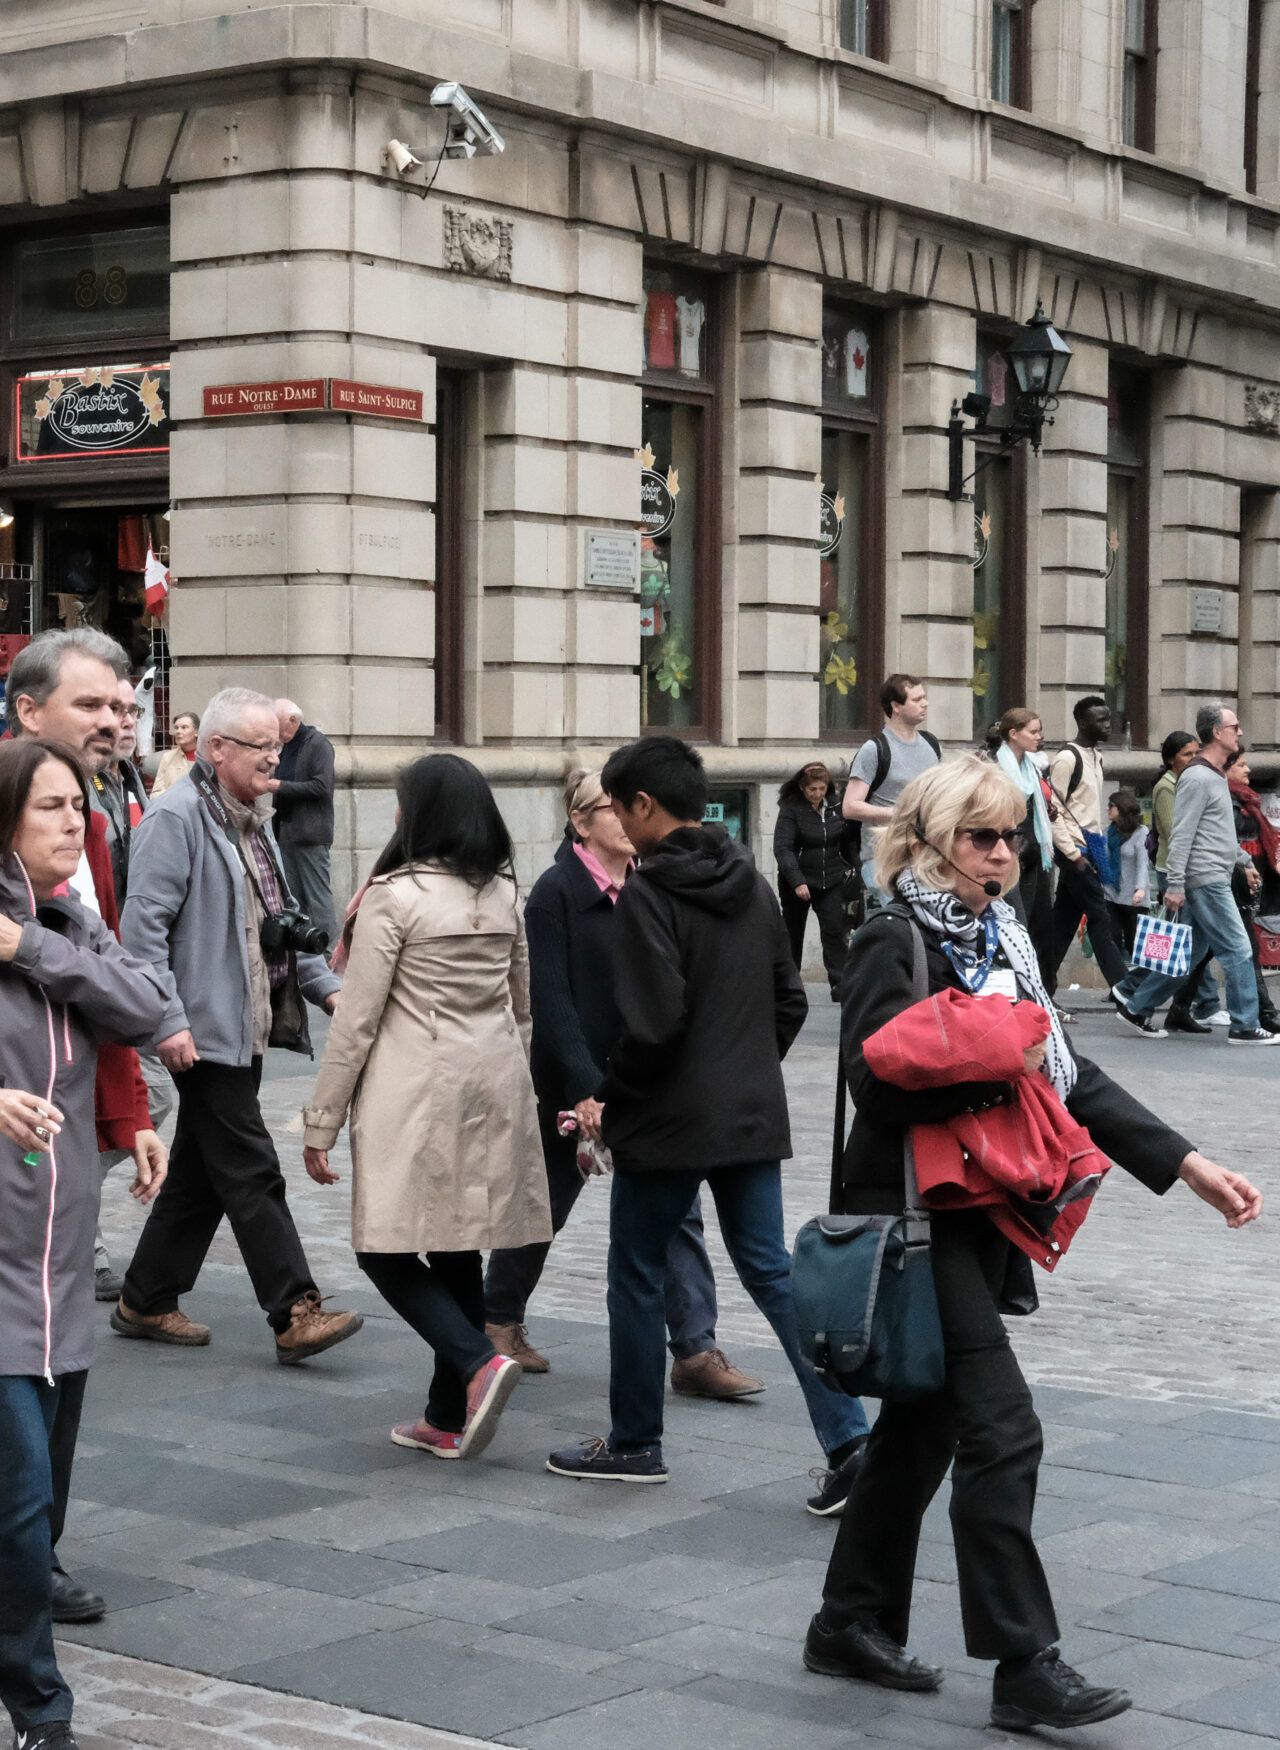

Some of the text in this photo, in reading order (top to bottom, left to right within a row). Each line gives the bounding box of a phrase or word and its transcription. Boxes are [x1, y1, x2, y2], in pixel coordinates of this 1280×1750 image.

[211, 392, 234, 405] RUE
[340, 390, 355, 402] RUE
[59, 384, 129, 428] Bastix
[253, 403, 274, 411] OUEST
[71, 418, 135, 435] souvenirs
[200, 779, 229, 824] EOS DIGITAL
